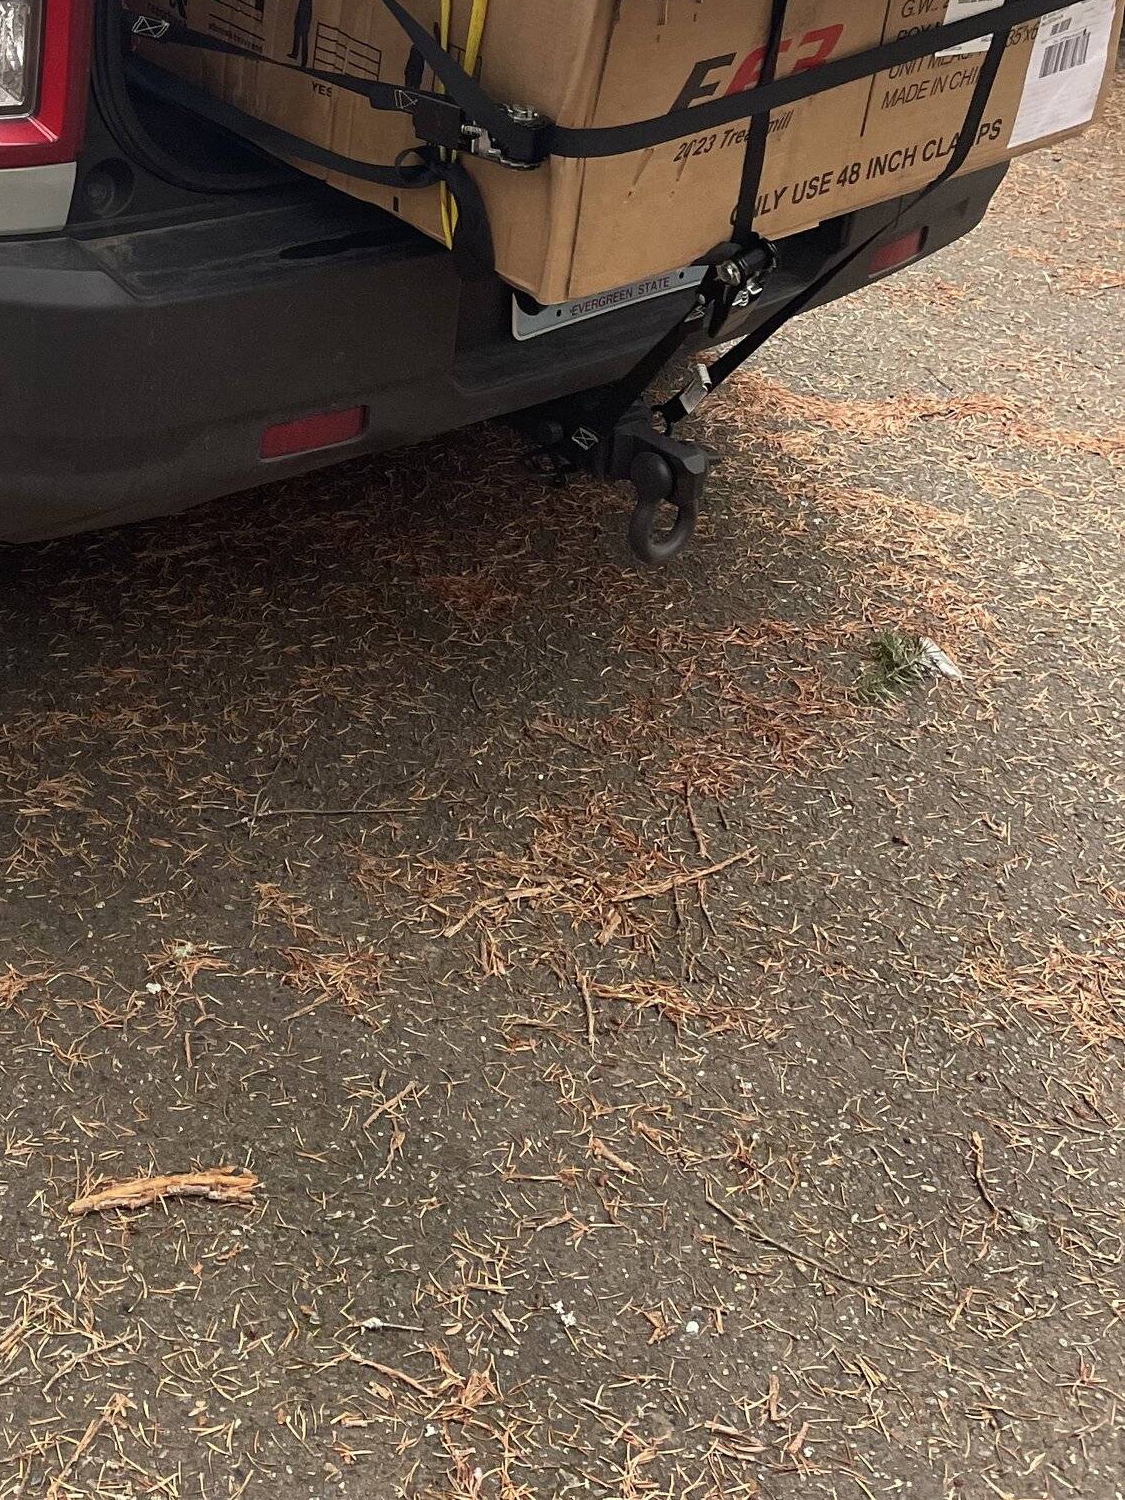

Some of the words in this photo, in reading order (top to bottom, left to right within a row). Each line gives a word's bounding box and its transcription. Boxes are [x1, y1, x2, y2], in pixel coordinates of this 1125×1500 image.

[311, 80, 334, 98] YES
[881, 80, 930, 110] MADE
[930, 74, 950, 97] IN
[950, 66, 979, 91] CHI
[720, 109, 795, 149] Treamill
[792, 171, 834, 204] USE
[836, 162, 862, 188] 48
[866, 145, 919, 180] INCH
[922, 118, 1003, 162] CLAPS
[570, 287, 633, 316] EVERGREEN
[638, 276, 671, 296] STATE
